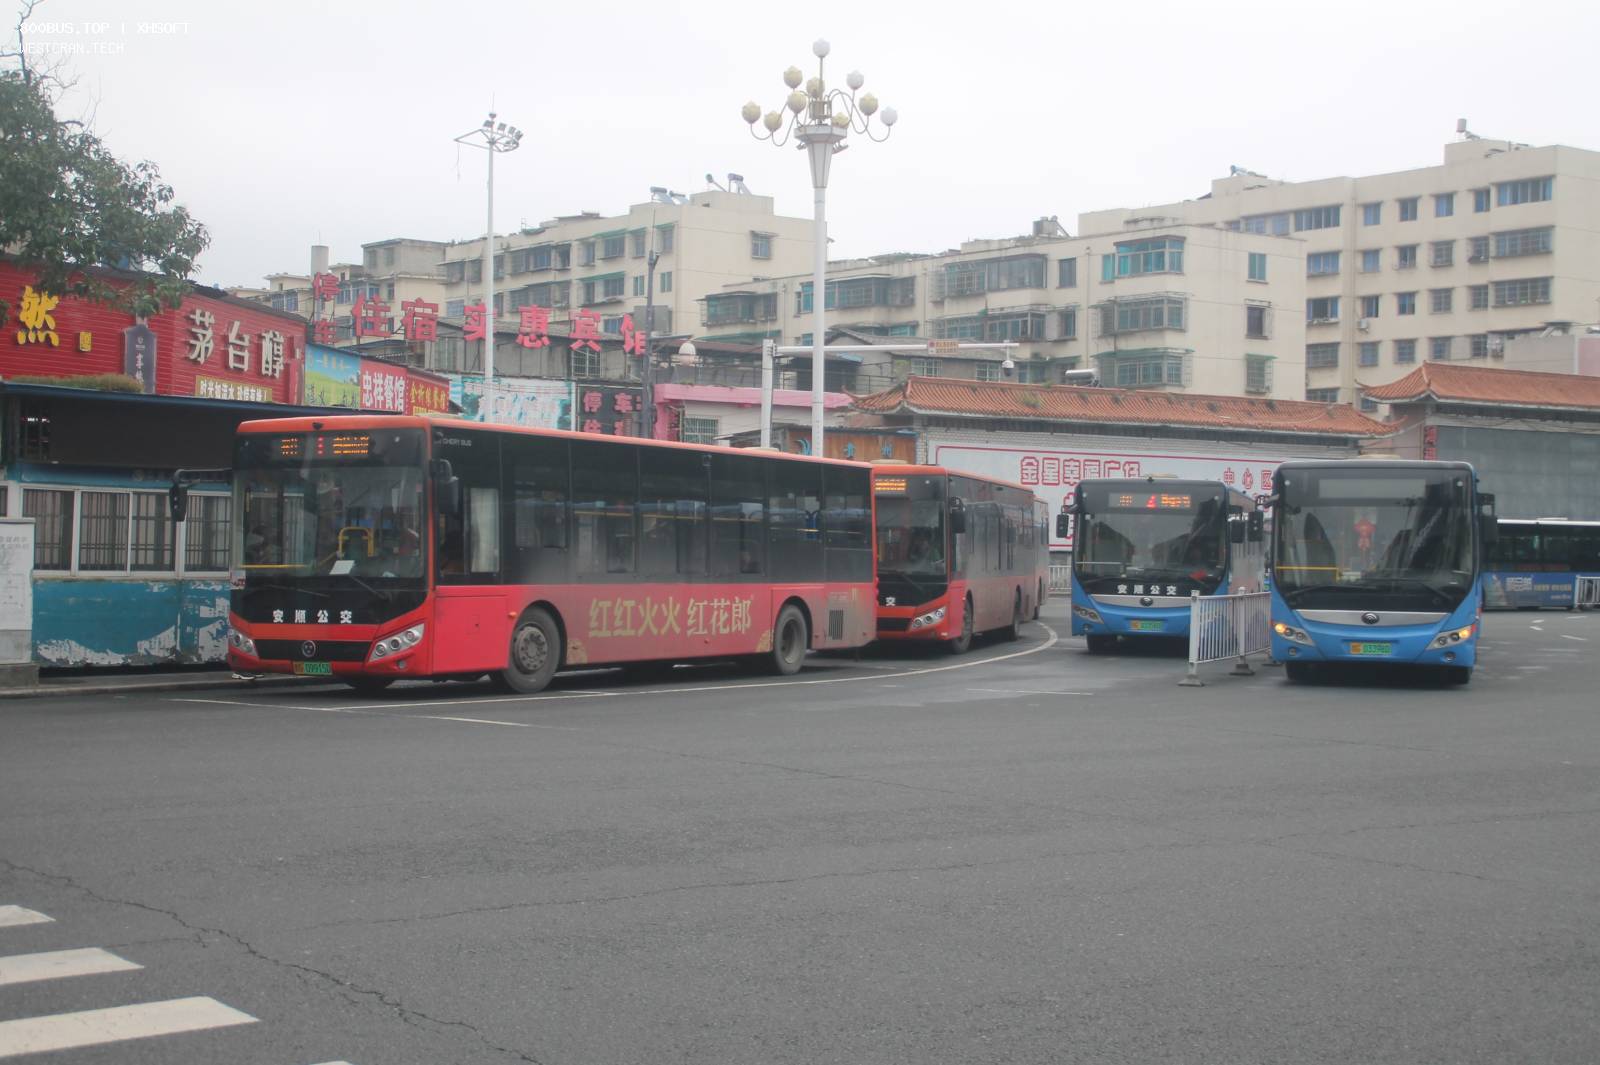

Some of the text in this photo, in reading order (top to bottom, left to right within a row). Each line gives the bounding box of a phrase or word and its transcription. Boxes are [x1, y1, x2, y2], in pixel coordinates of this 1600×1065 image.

[189, 308, 285, 379] 茅台醇
[362, 370, 406, 412] 忠祥餐馆
[1223, 467, 1273, 490] 中心区
[1117, 584, 1177, 596] 安顺公交
[272, 609, 353, 624] 安顺公交
[588, 596, 752, 638] 红红火火 红花郎
